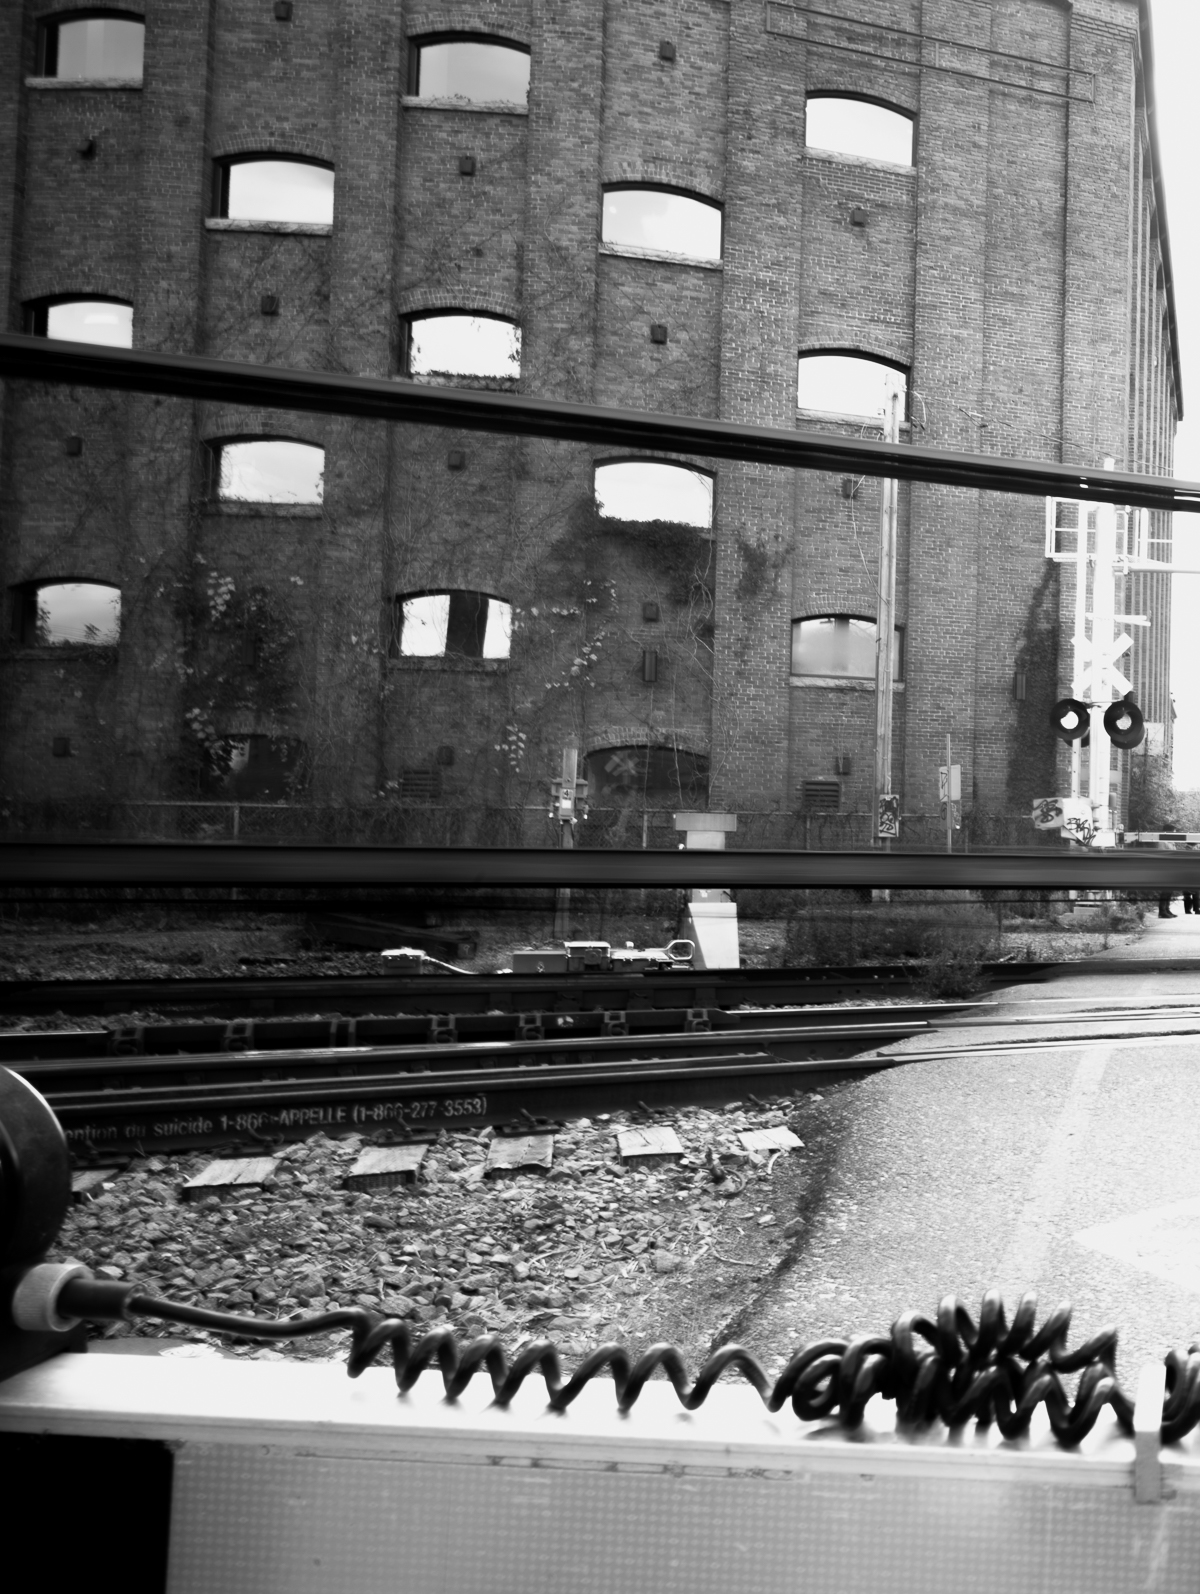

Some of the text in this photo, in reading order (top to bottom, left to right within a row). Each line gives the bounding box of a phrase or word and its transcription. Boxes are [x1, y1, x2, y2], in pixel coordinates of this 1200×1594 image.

[64, 1124, 117, 1140] ention
[125, 1123, 146, 1138] du
[153, 1117, 213, 1136] suicide
